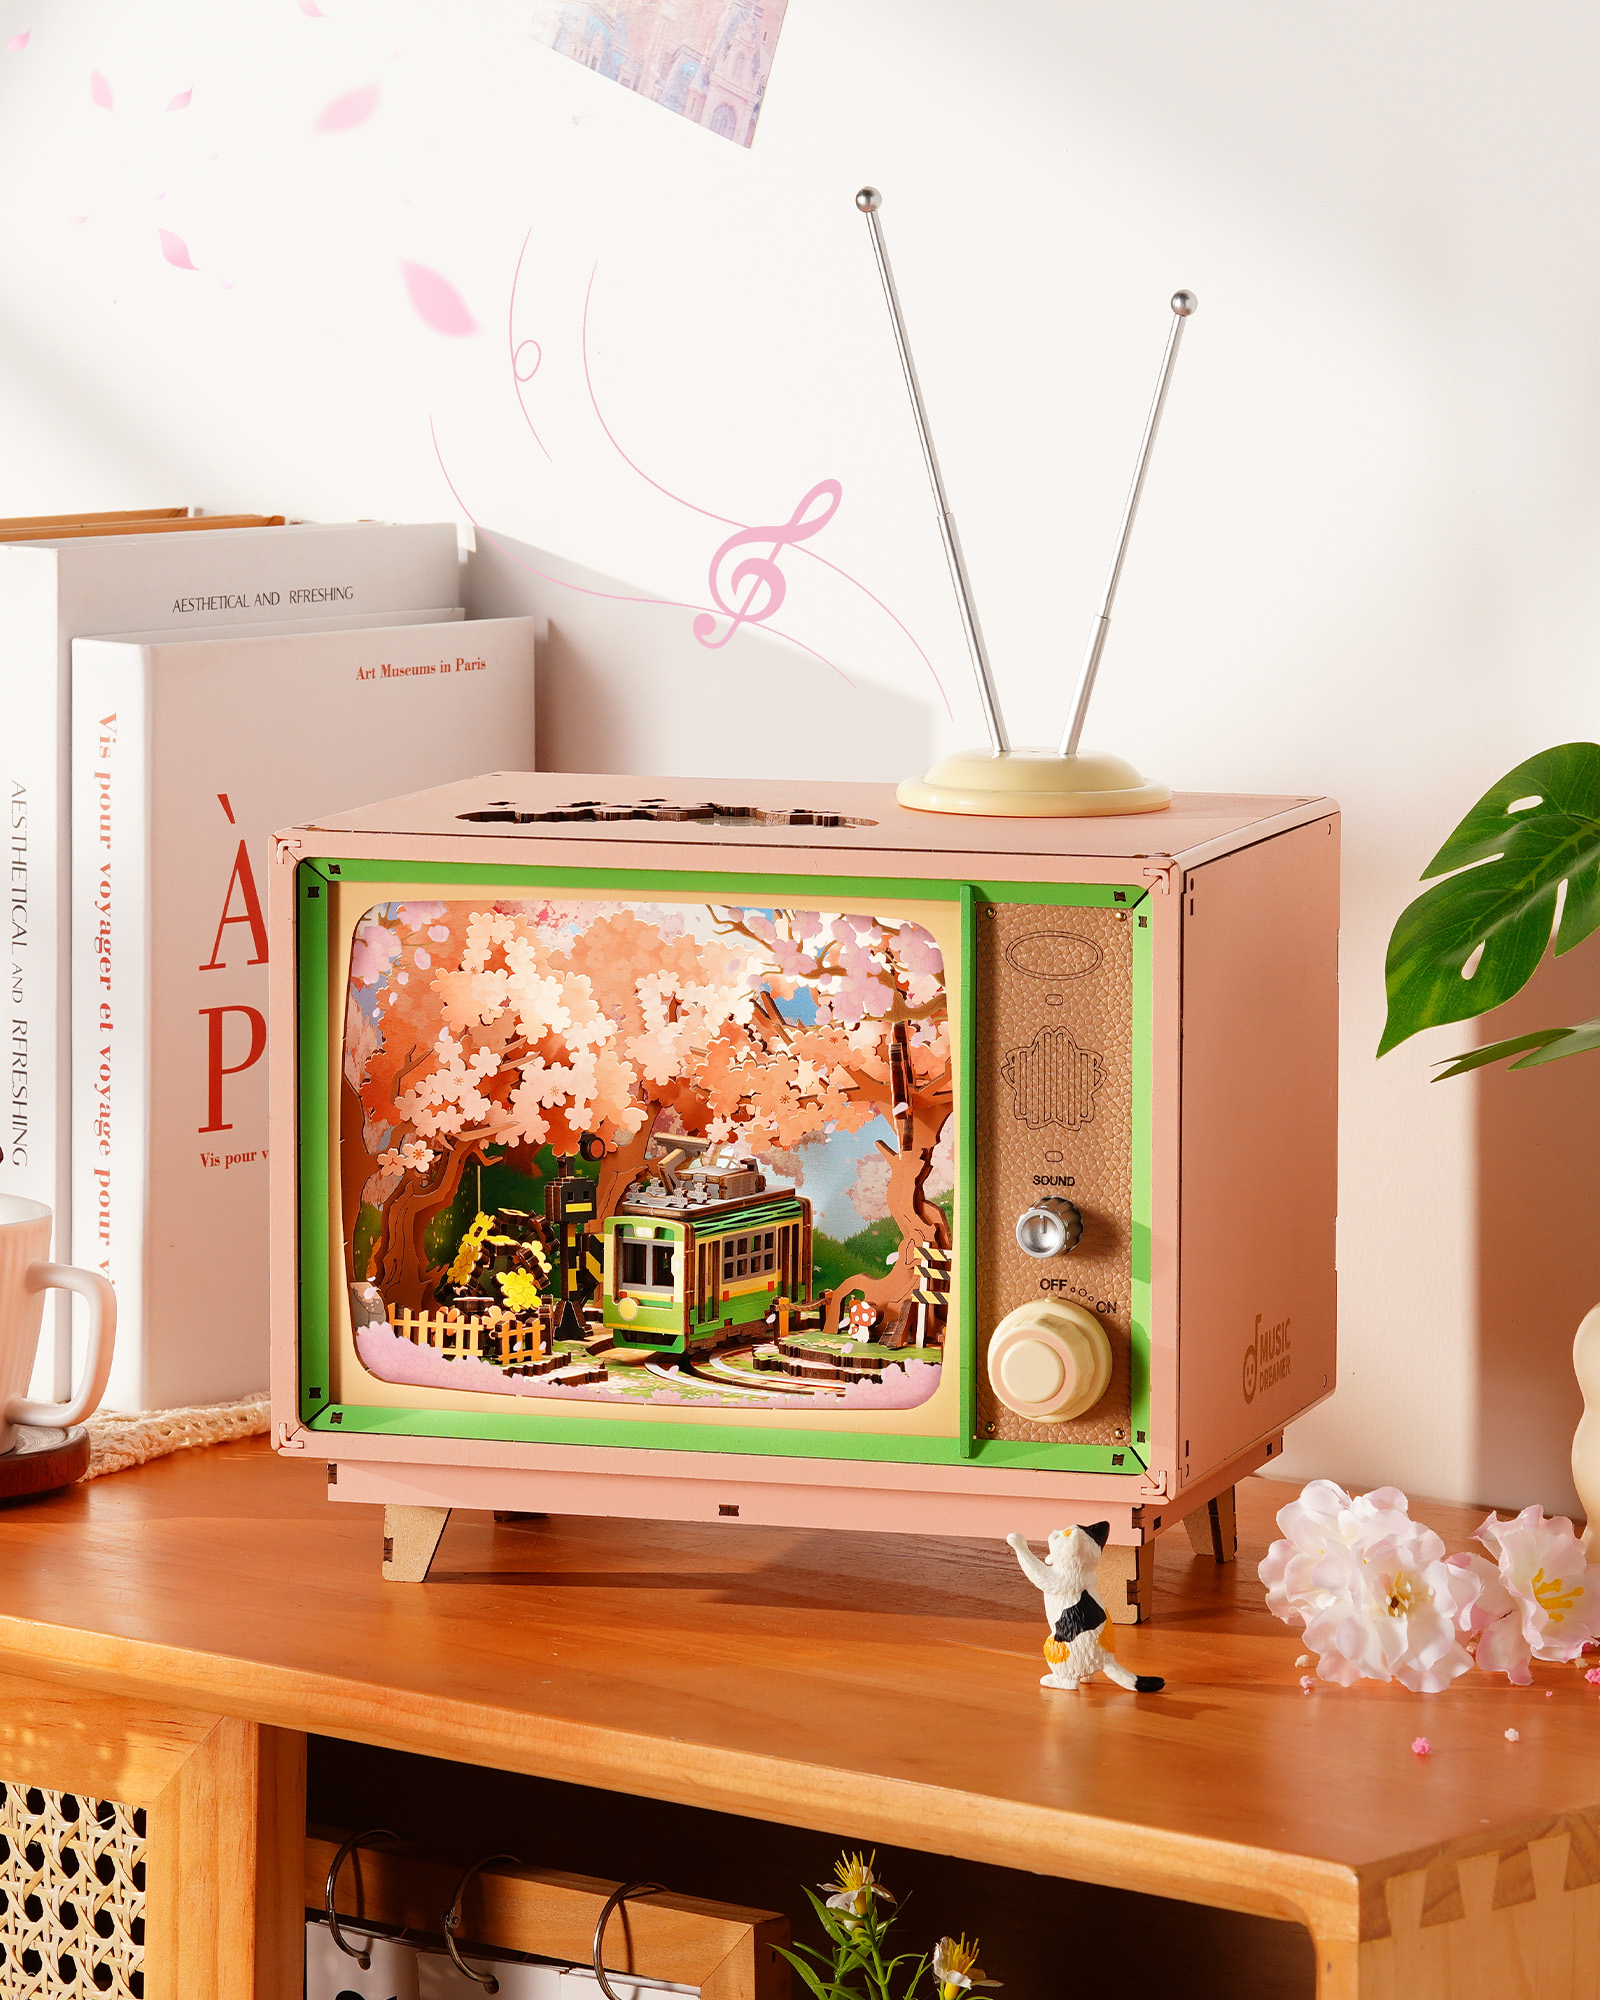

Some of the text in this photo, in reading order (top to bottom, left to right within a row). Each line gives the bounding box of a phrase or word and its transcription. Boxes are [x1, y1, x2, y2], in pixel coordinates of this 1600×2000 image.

[172, 593, 250, 613] AESTHETICAL
[253, 591, 280, 606] AND
[355, 657, 486, 681] Art Museums in Paris
[98, 711, 118, 759] Vis
[93, 769, 112, 850] pour
[10, 779, 28, 955] AESTHETICAL
[93, 862, 112, 991] voyager
[11, 962, 24, 1004] AND
[98, 1002, 114, 1033] et
[93, 1044, 112, 1156] voyage
[200, 1152, 221, 1168] Vis
[224, 1151, 258, 1170] pour
[1032, 1174, 1076, 1187] SOUND
[93, 1166, 112, 1247] pour
[1039, 1278, 1068, 1291] OFF
[1095, 1300, 1118, 1314] ON
[1260, 1317, 1291, 1367] MUSIC
